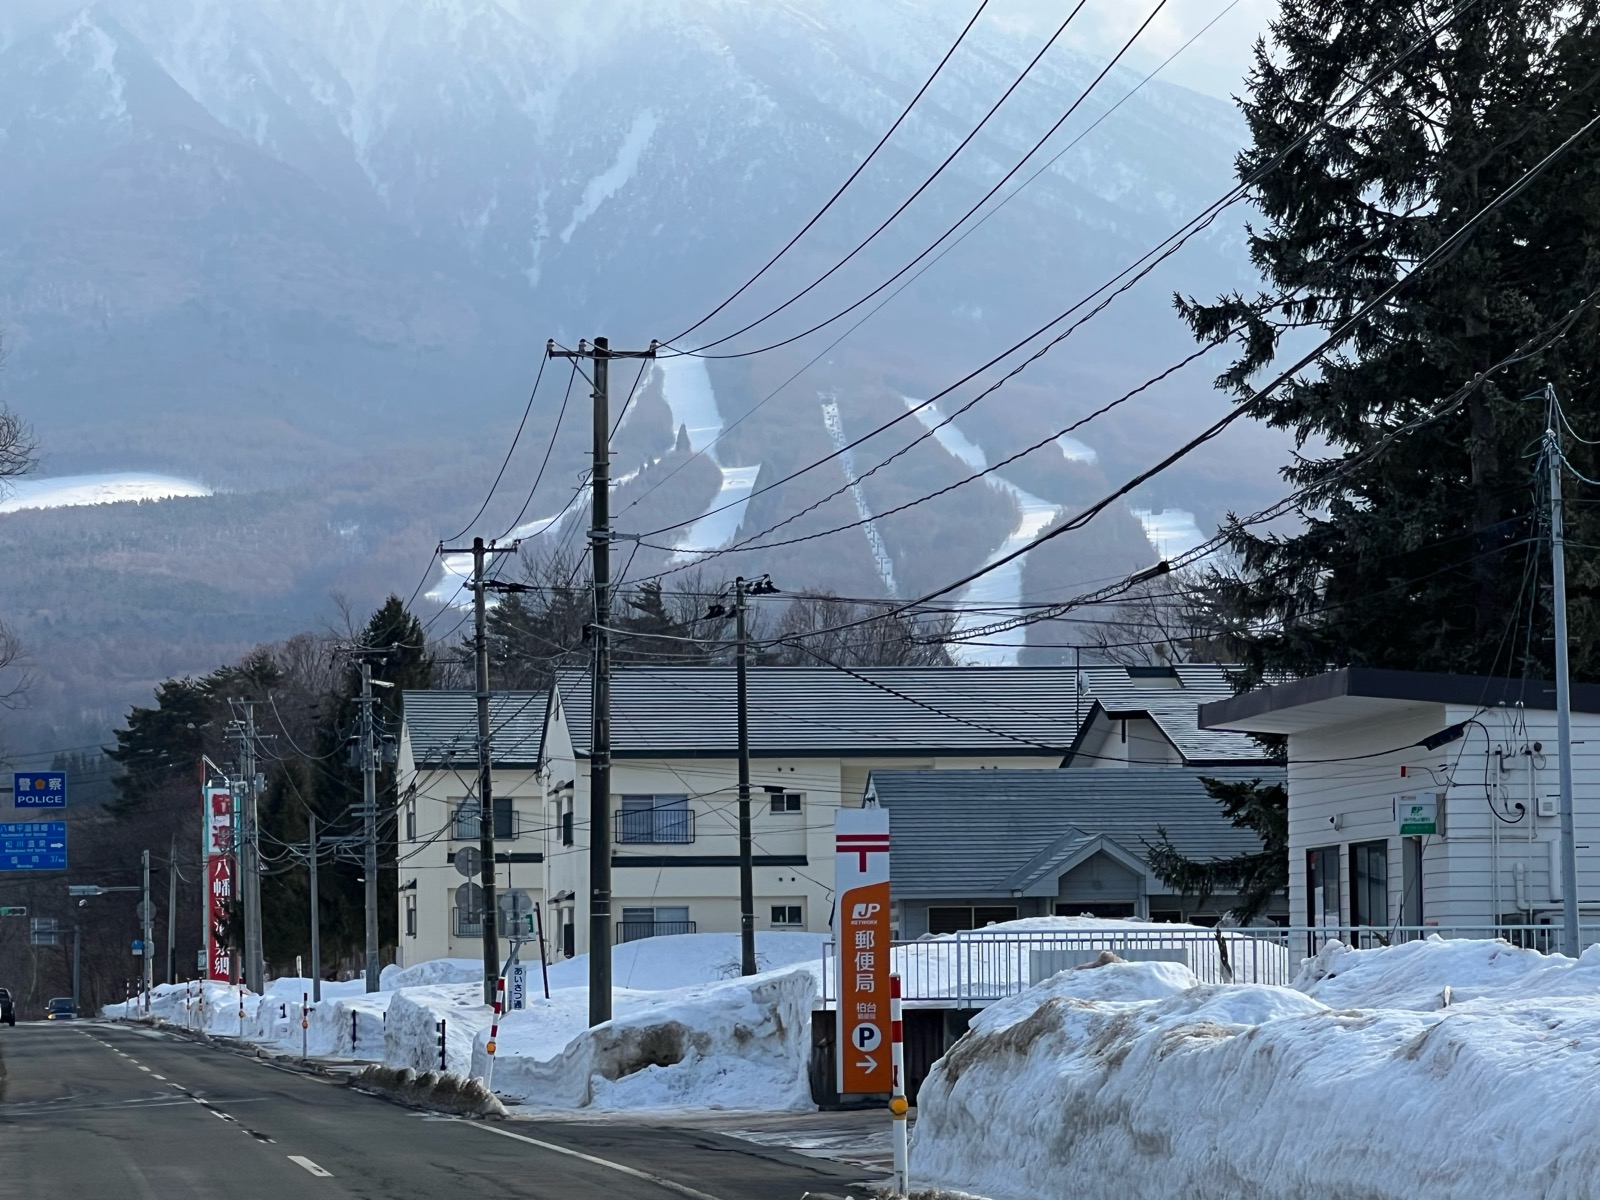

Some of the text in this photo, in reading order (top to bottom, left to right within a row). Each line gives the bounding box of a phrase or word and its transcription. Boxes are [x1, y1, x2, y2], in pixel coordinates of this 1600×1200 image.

[17, 795, 62, 804] POLICE
[851, 903, 880, 919] JP
[855, 930, 875, 993] 郵便局
[859, 1027, 875, 1048] P
